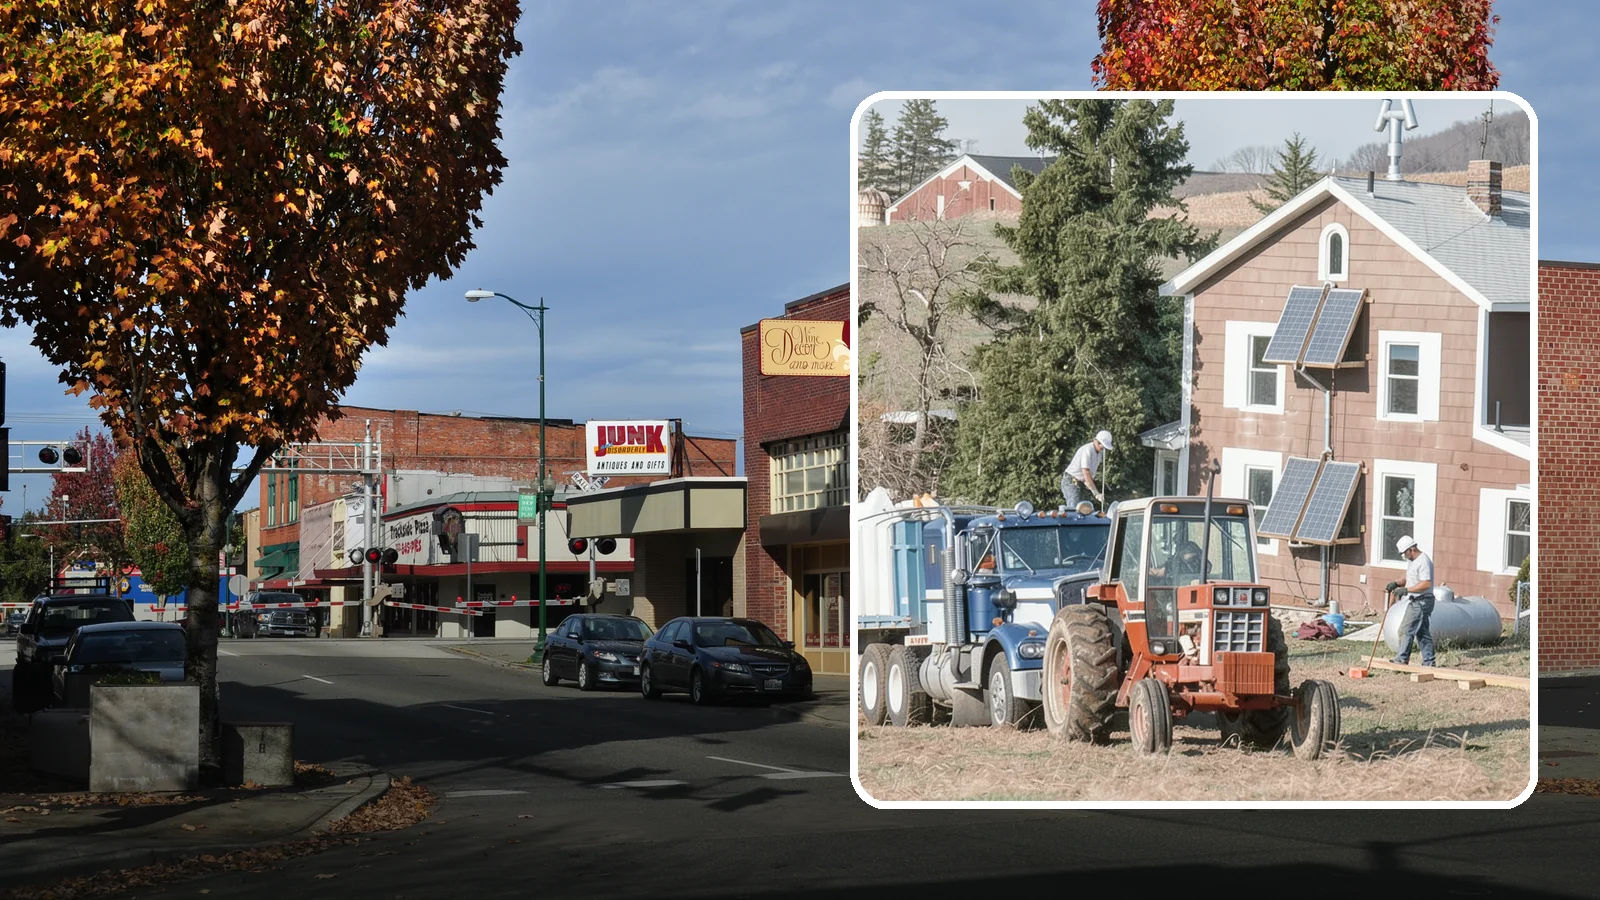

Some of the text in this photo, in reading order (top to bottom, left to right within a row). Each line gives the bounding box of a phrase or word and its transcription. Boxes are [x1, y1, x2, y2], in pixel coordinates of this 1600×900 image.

[595, 425, 665, 457] JUNK
[607, 446, 646, 454] DISORDERLY
[597, 461, 666, 470] ANTIQUES AND GIFTS
[390, 519, 429, 539] Trackside Pizza
